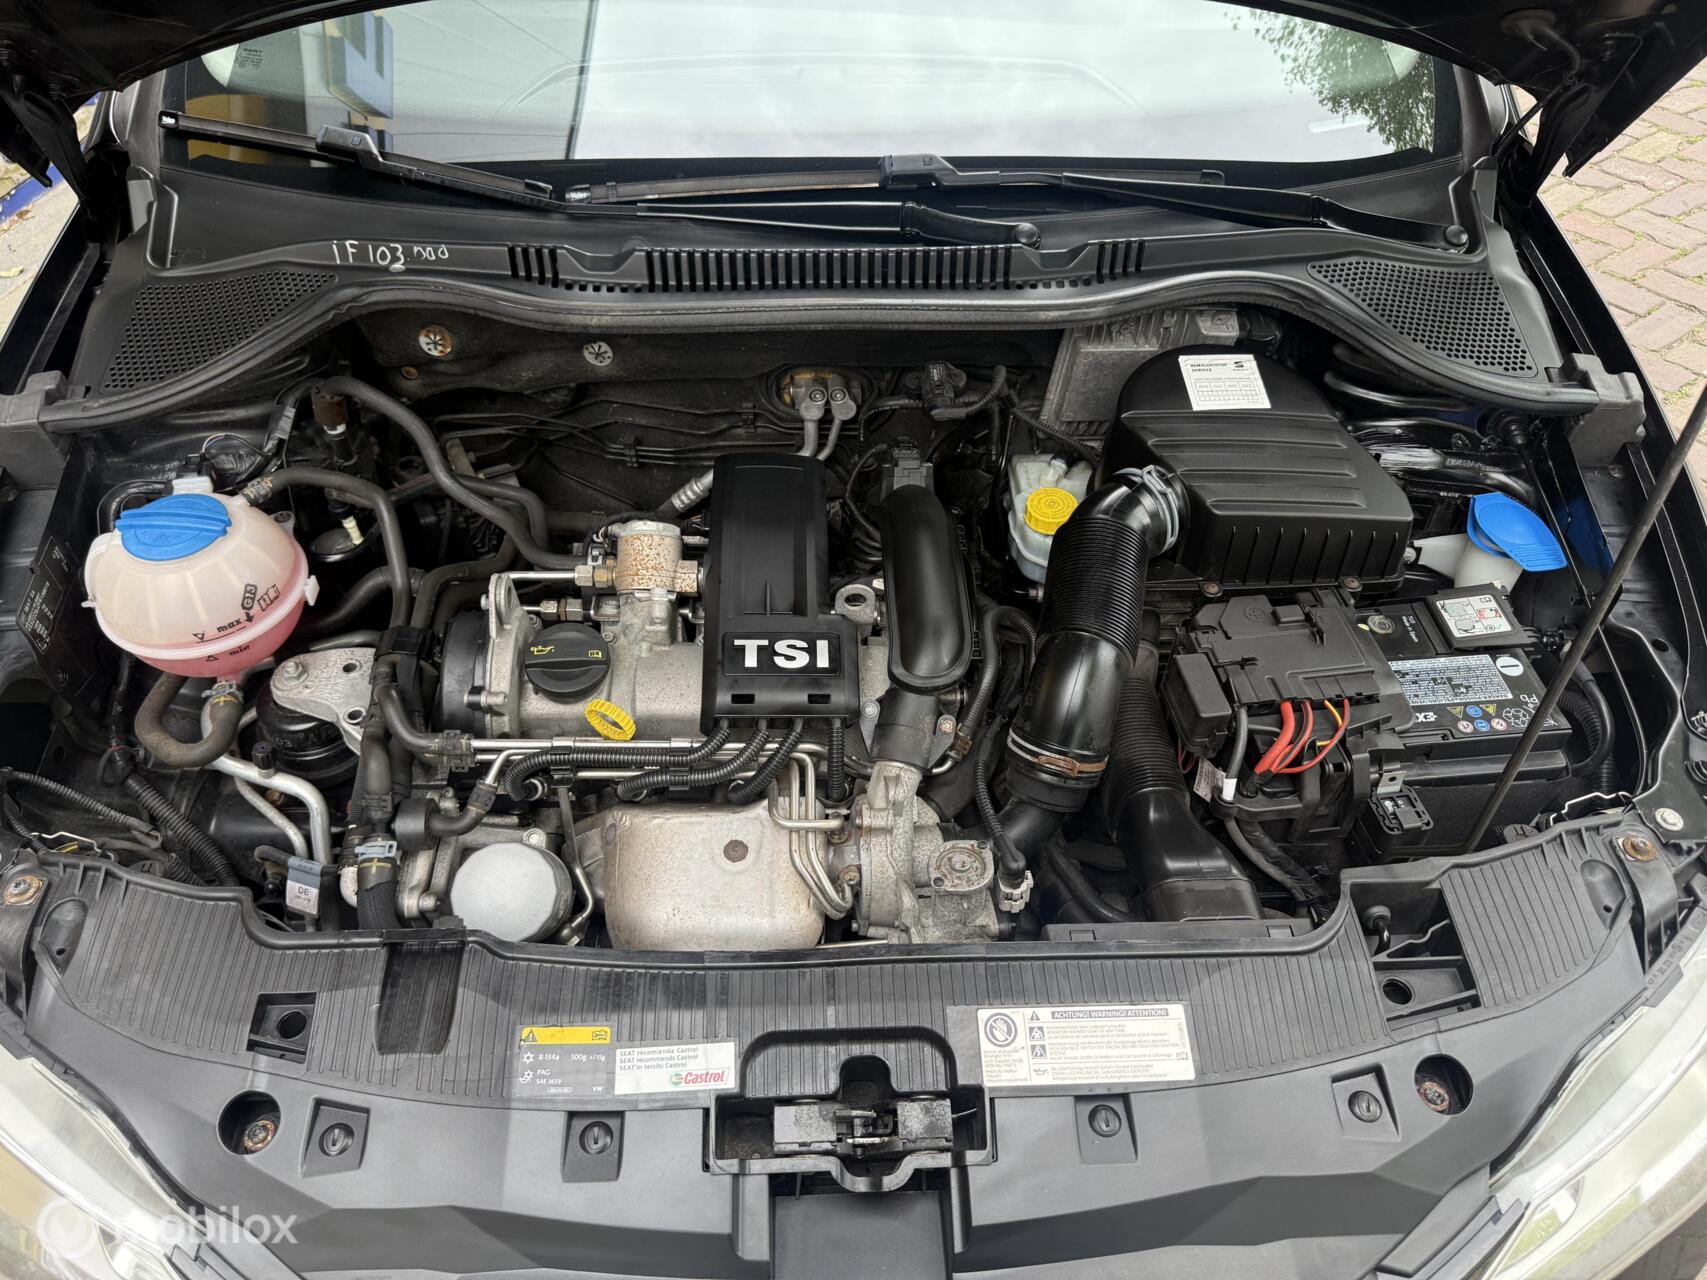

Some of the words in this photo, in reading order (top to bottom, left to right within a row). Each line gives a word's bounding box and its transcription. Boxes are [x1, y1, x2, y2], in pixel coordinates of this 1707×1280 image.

[217, 618, 242, 633] max
[228, 644, 251, 657] min
[733, 638, 830, 669] TSI
[1053, 1010, 1090, 1019] ACHTUNG!
[1091, 1009, 1126, 1018] WARNING!
[1127, 1008, 1168, 1017] ATTENTION!
[619, 1049, 635, 1057] SEAT
[636, 1048, 675, 1056] recomienda
[676, 1046, 699, 1054] Castrol
[538, 1053, 560, 1062] R-134a
[570, 1053, 588, 1062] 500g
[619, 1056, 635, 1064] SEAT
[636, 1055, 675, 1063] recommends
[676, 1053, 699, 1061] Castrol
[664, 1061, 687, 1069] Castrol
[536, 1068, 550, 1076] PAG
[683, 1070, 725, 1085] Castrol
[592, 1085, 604, 1093] VW
